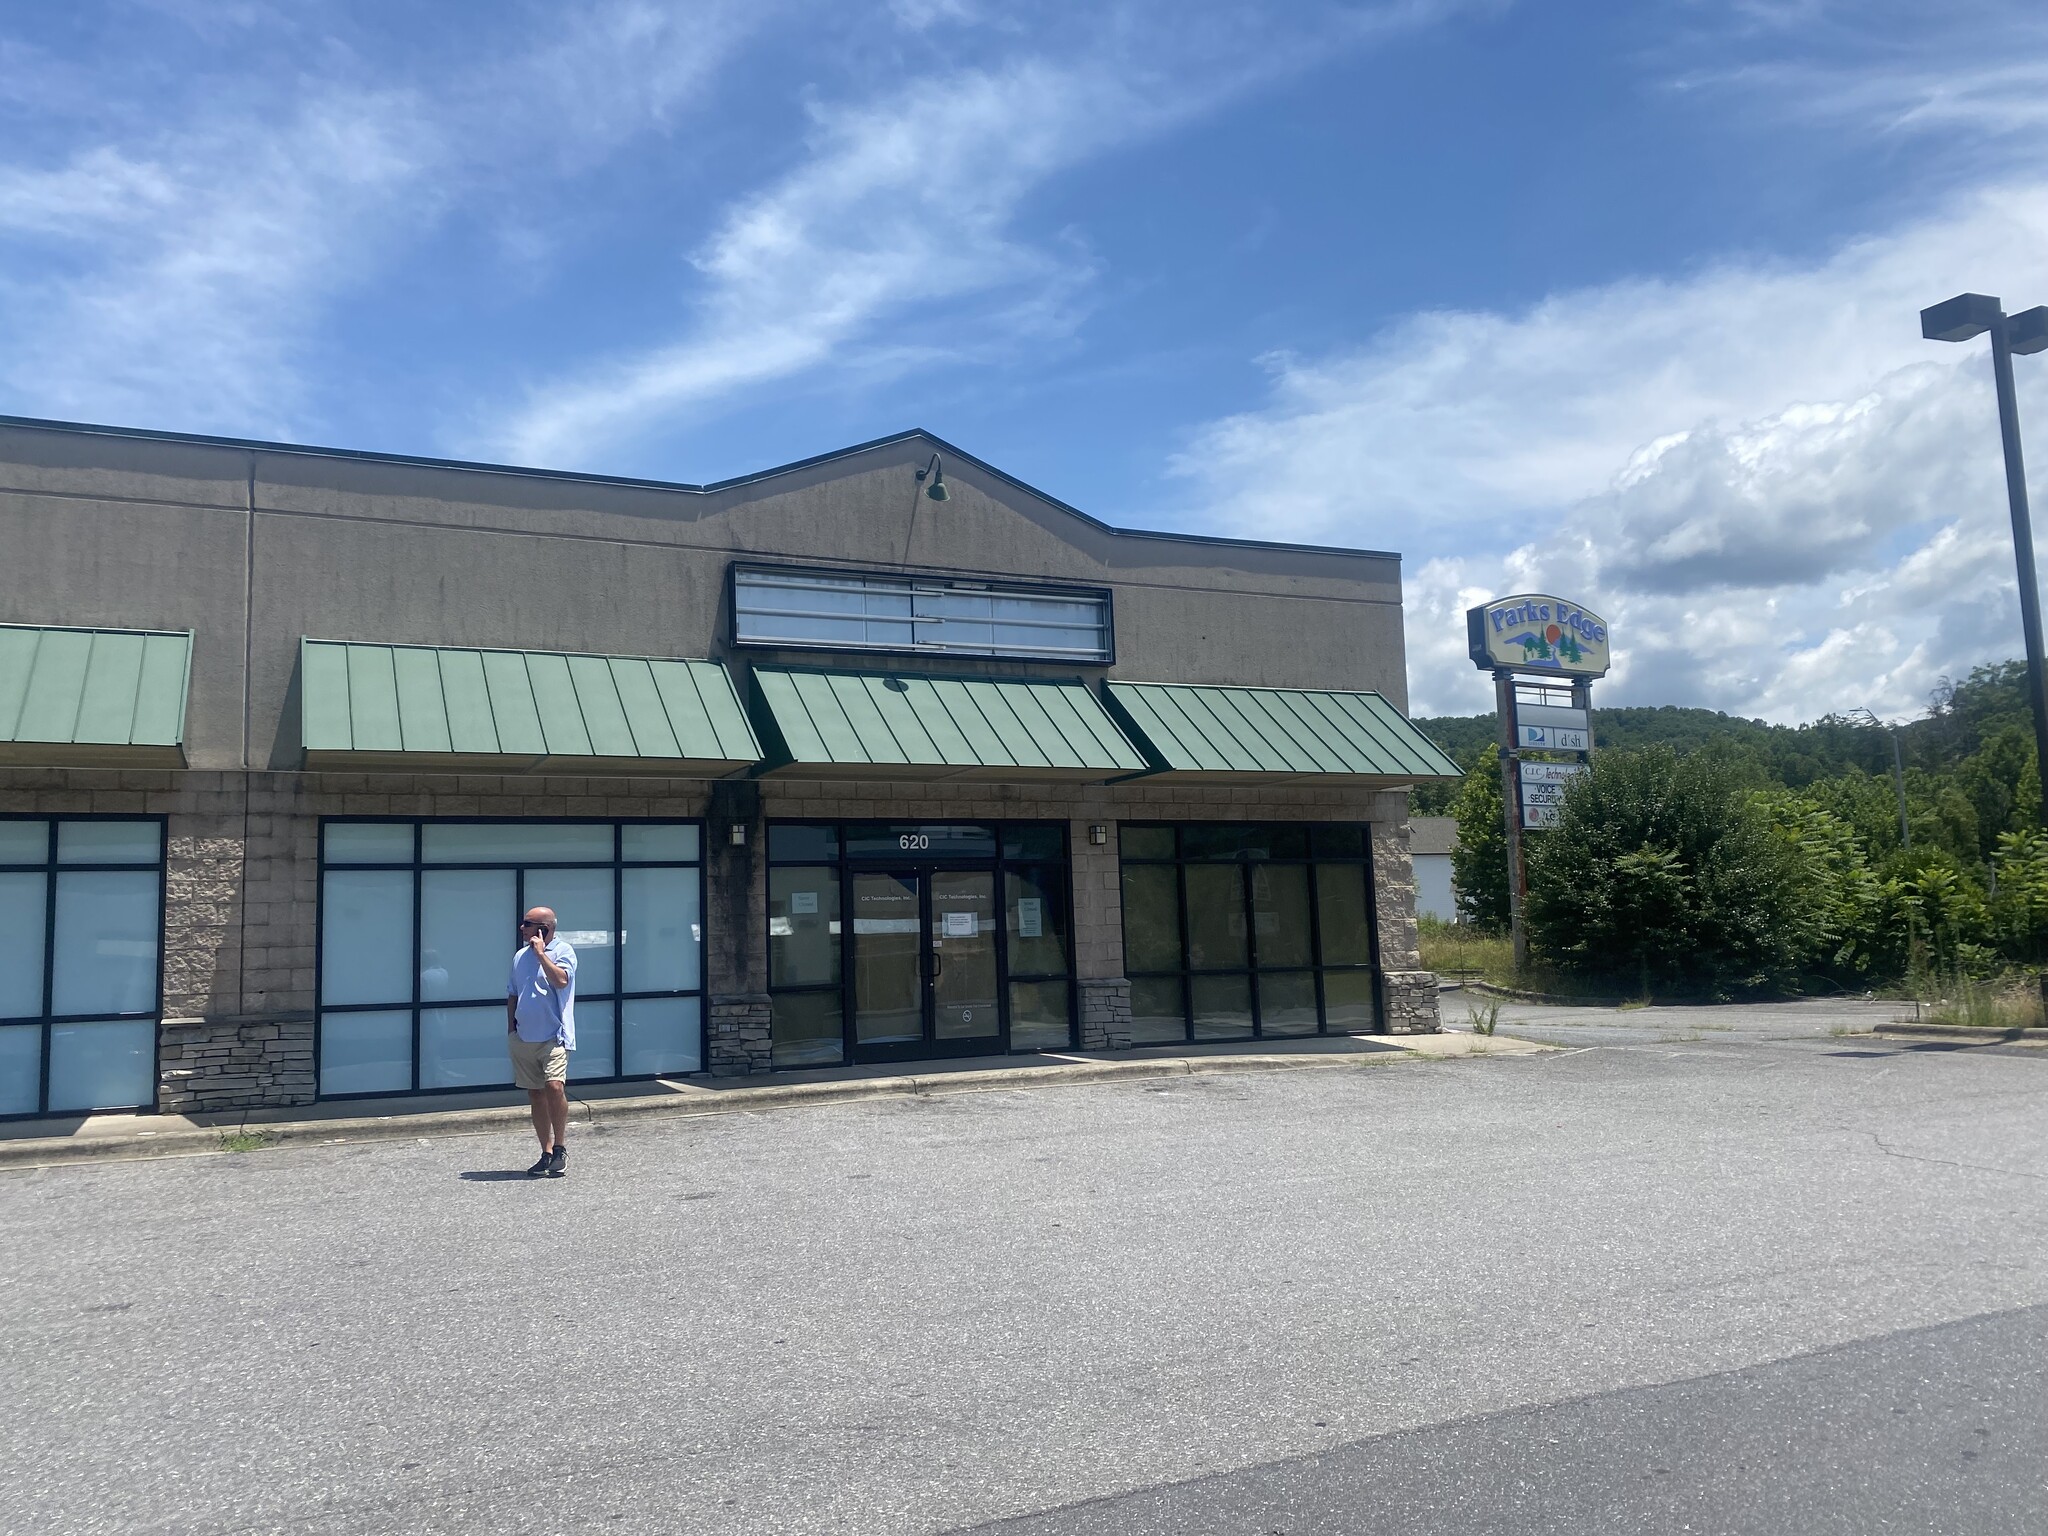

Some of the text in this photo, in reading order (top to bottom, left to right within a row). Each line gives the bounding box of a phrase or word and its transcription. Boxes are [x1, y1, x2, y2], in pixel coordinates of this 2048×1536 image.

[1490, 600, 1606, 643] Parks Edge
[1536, 784, 1556, 794] VOICE
[899, 834, 929, 850] 620
